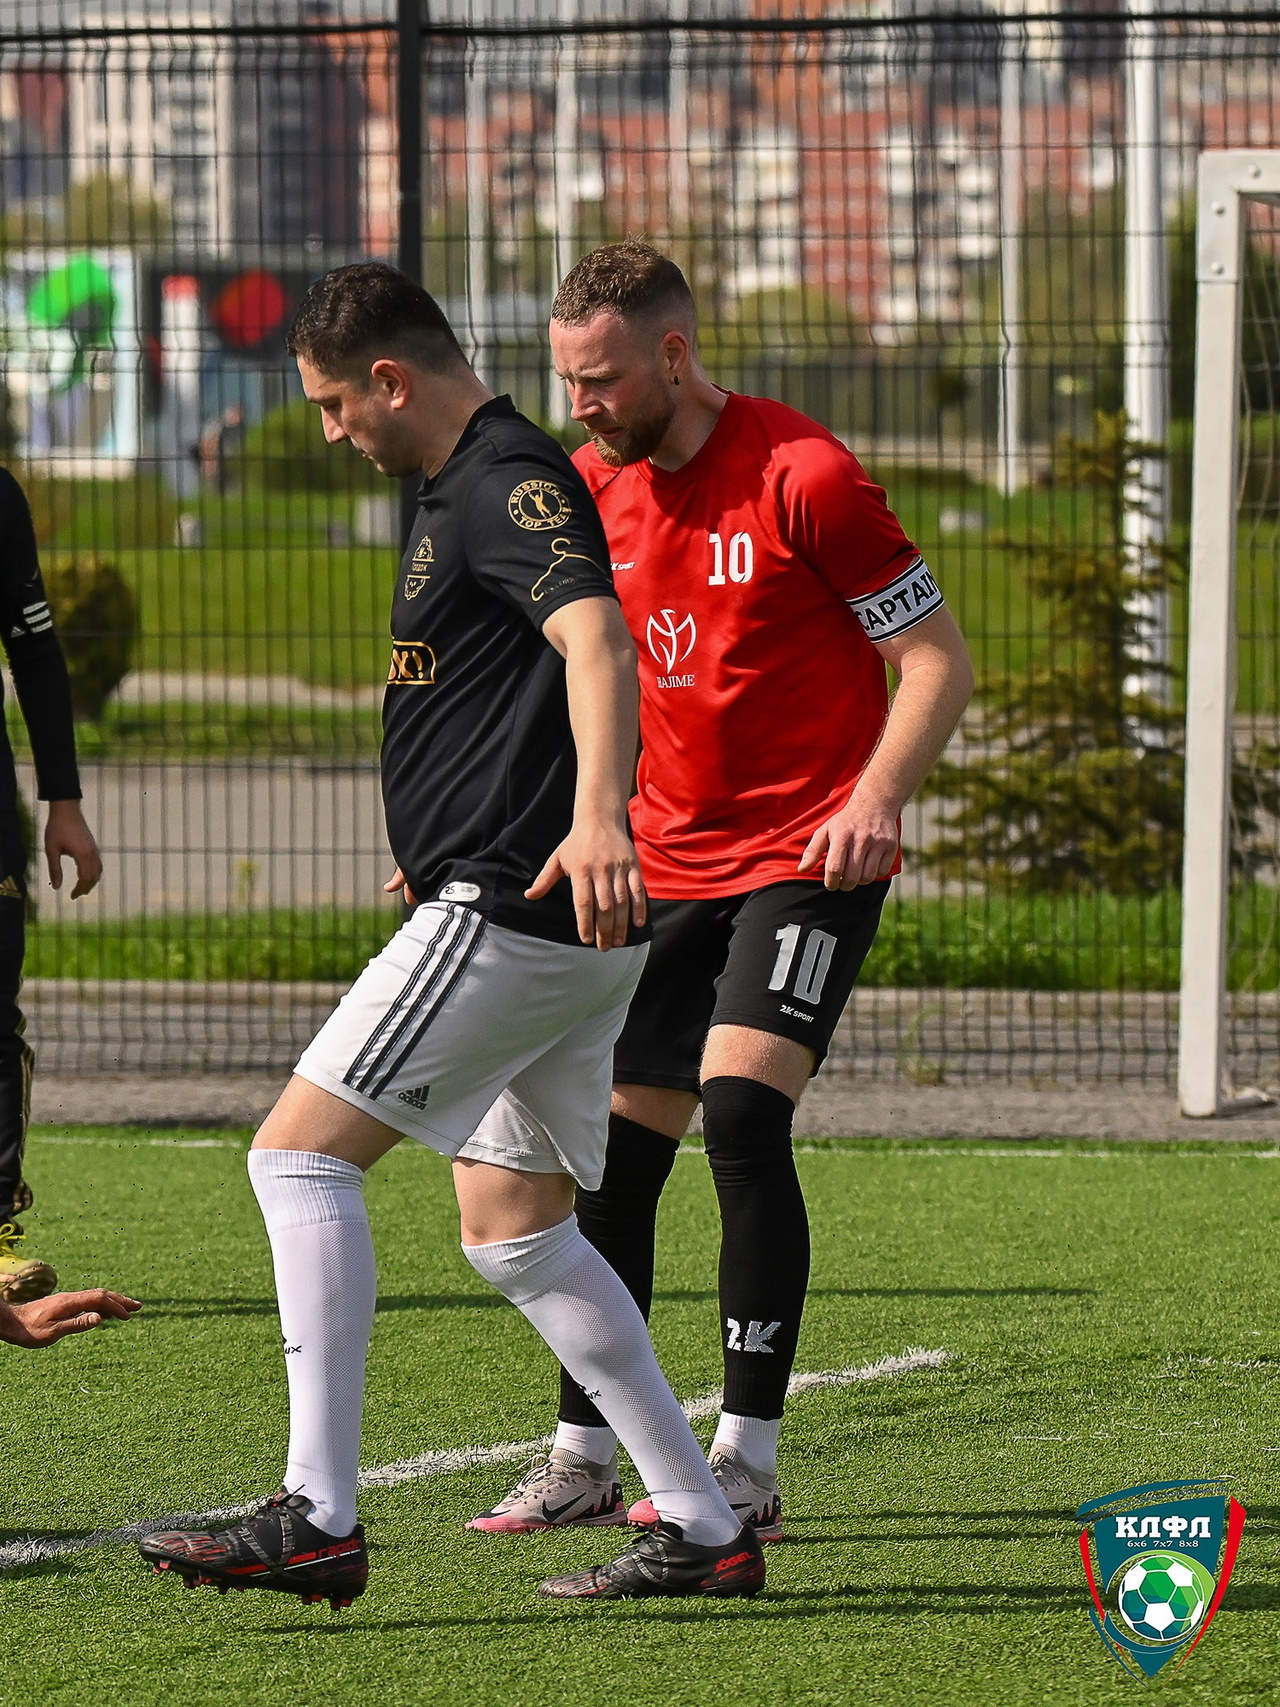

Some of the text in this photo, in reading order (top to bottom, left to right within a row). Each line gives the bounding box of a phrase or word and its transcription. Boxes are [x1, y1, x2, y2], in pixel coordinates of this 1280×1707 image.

[520, 516, 542, 528] TOP
[708, 532, 754, 586] 10
[768, 922, 838, 1005] 10
[779, 1004, 815, 1023] 2K SPORT
[726, 1317, 782, 1354] 2K
